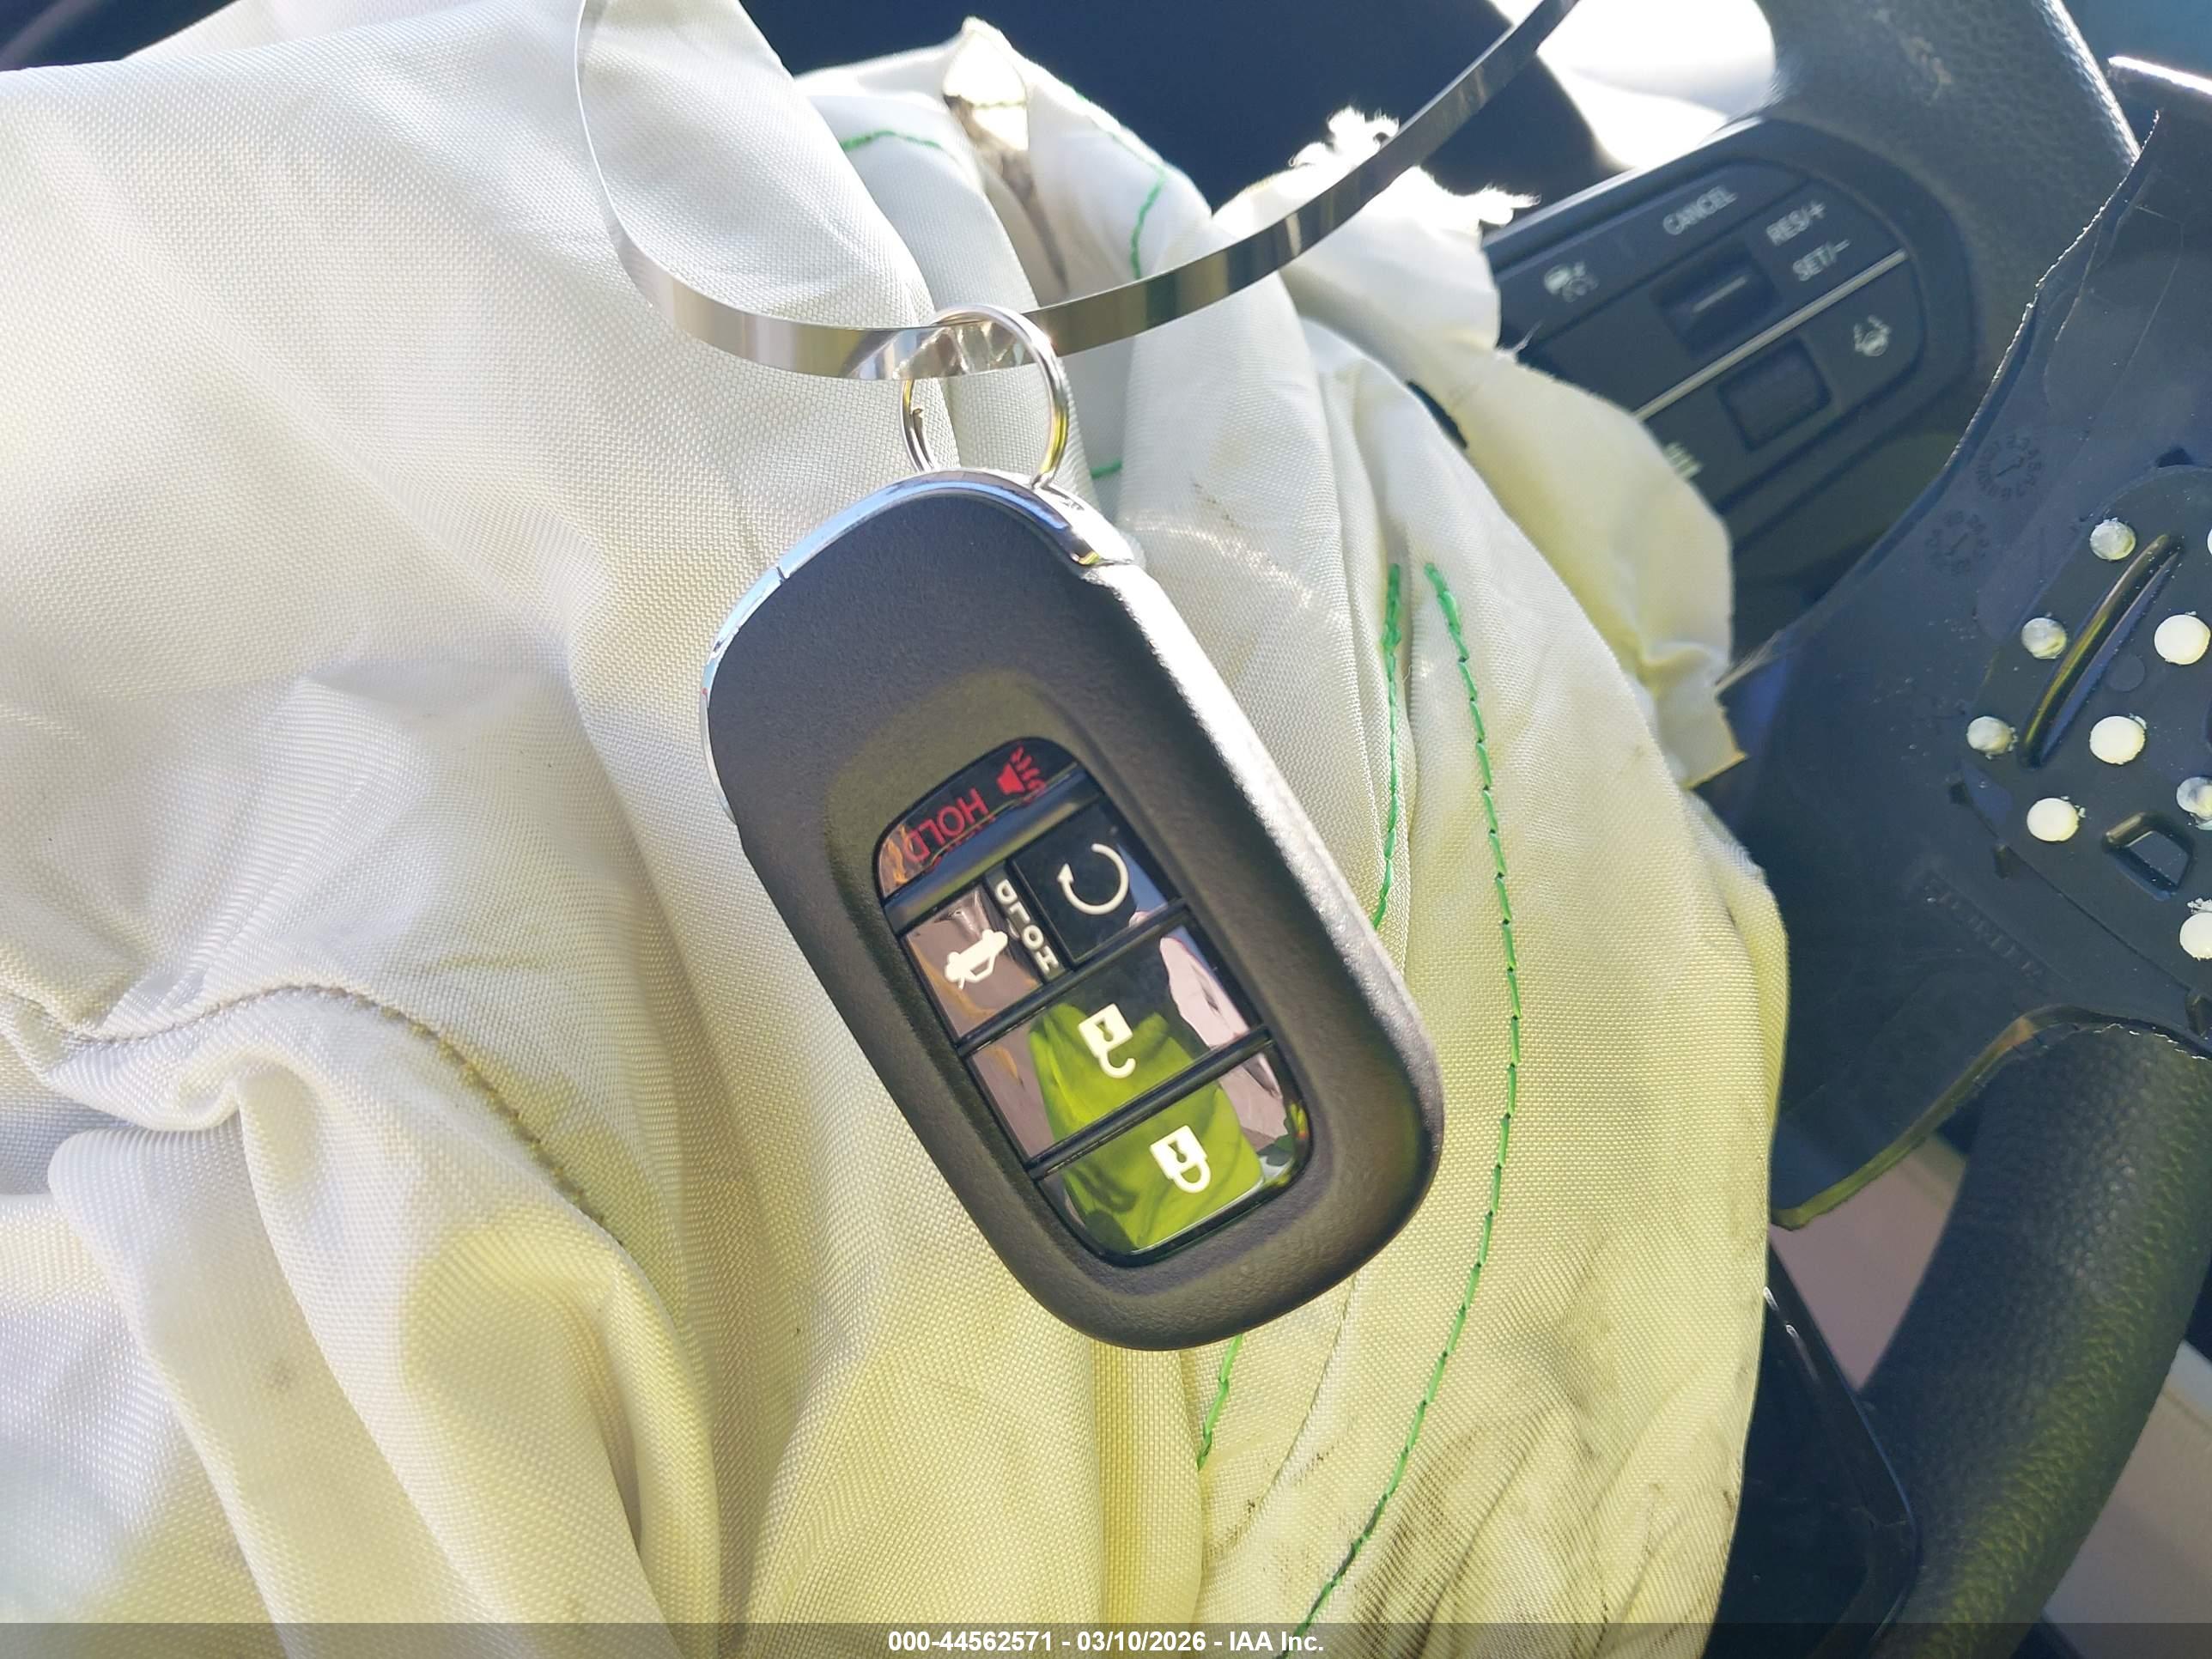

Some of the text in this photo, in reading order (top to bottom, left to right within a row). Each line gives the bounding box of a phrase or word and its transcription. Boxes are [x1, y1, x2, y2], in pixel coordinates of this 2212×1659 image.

[1662, 184, 1739, 235] CANCEL
[905, 787, 989, 863] HOLD
[995, 878, 1059, 973] HOLD
